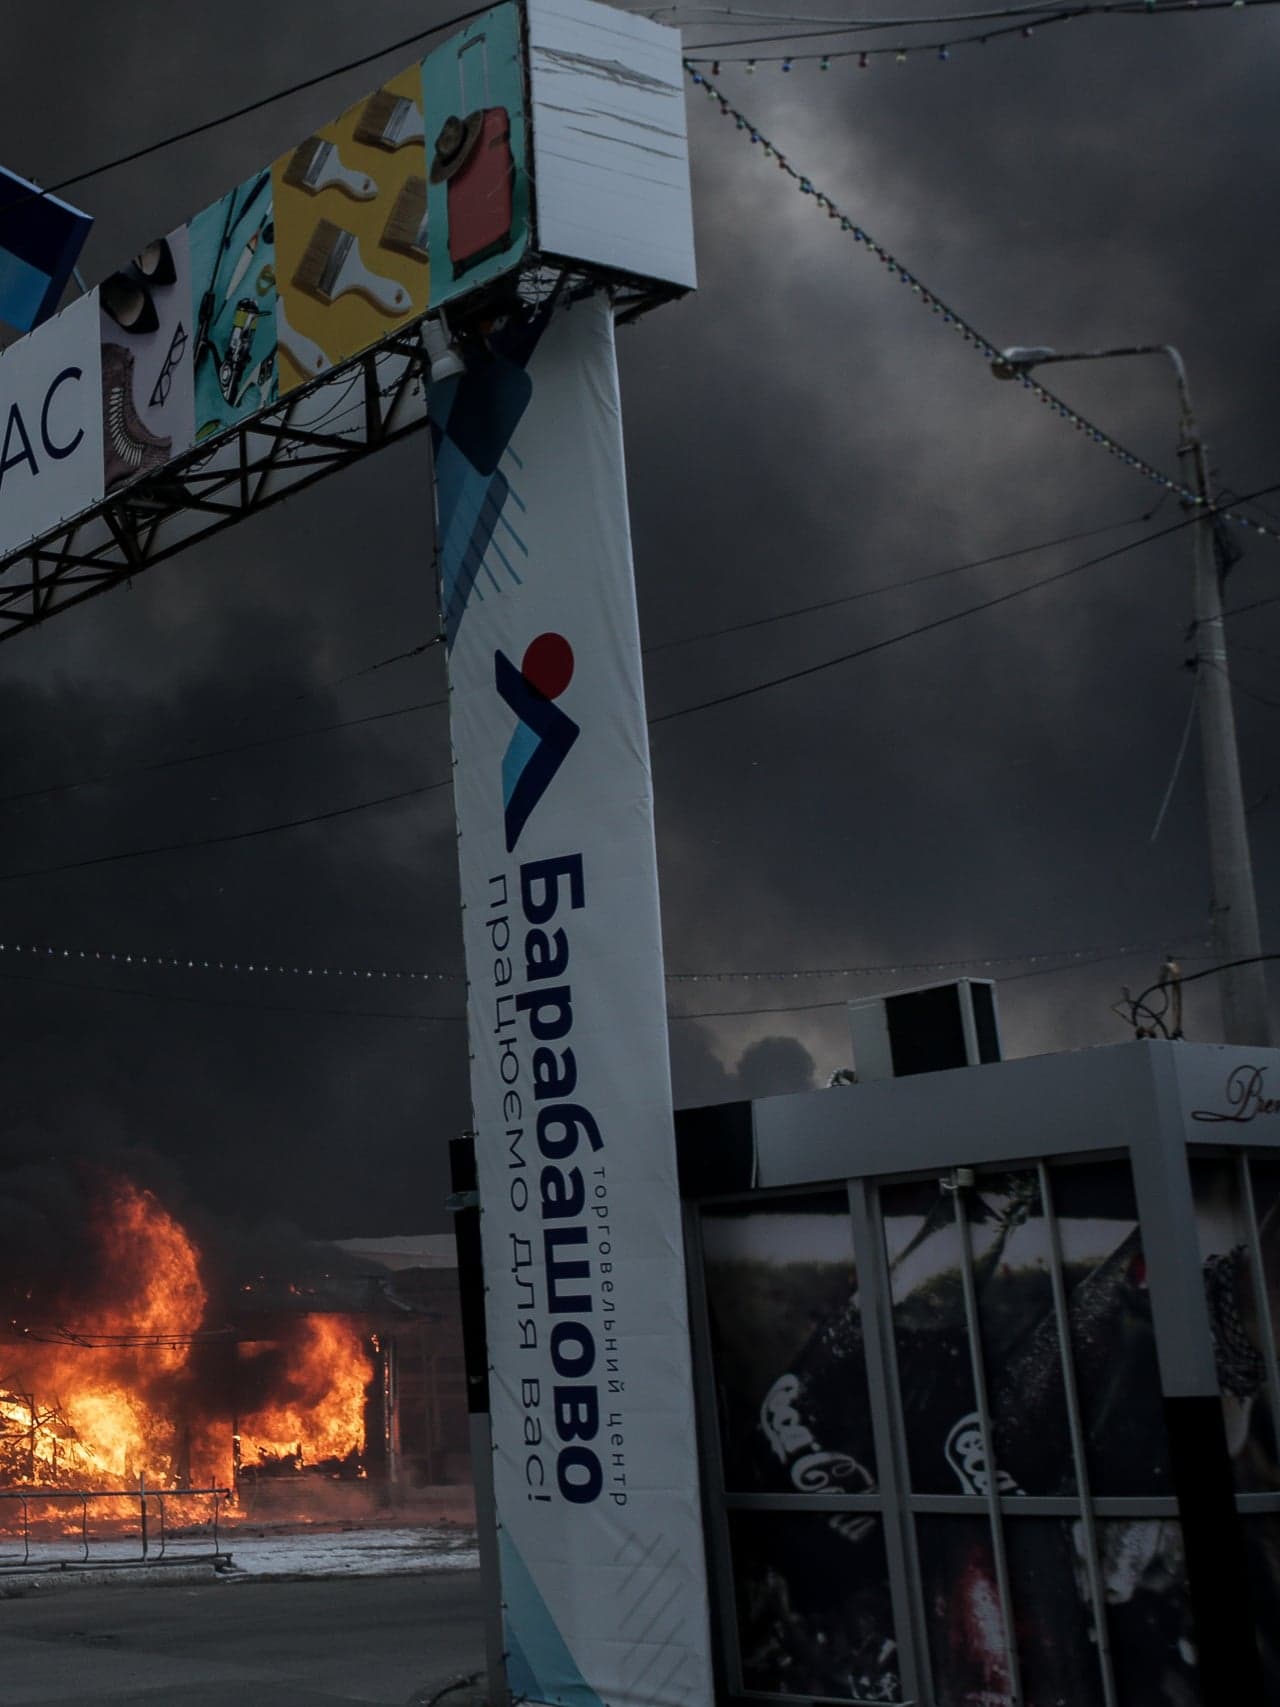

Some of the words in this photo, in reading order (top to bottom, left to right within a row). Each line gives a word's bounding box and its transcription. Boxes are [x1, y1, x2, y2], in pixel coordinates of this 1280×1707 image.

[485, 873, 529, 1212] працюємо
[515, 852, 604, 1504] Барабашово
[508, 1232, 538, 1349] для
[591, 1167, 625, 1394] торговельний
[521, 1378, 552, 1503] вас!
[607, 1412, 628, 1507] центр
